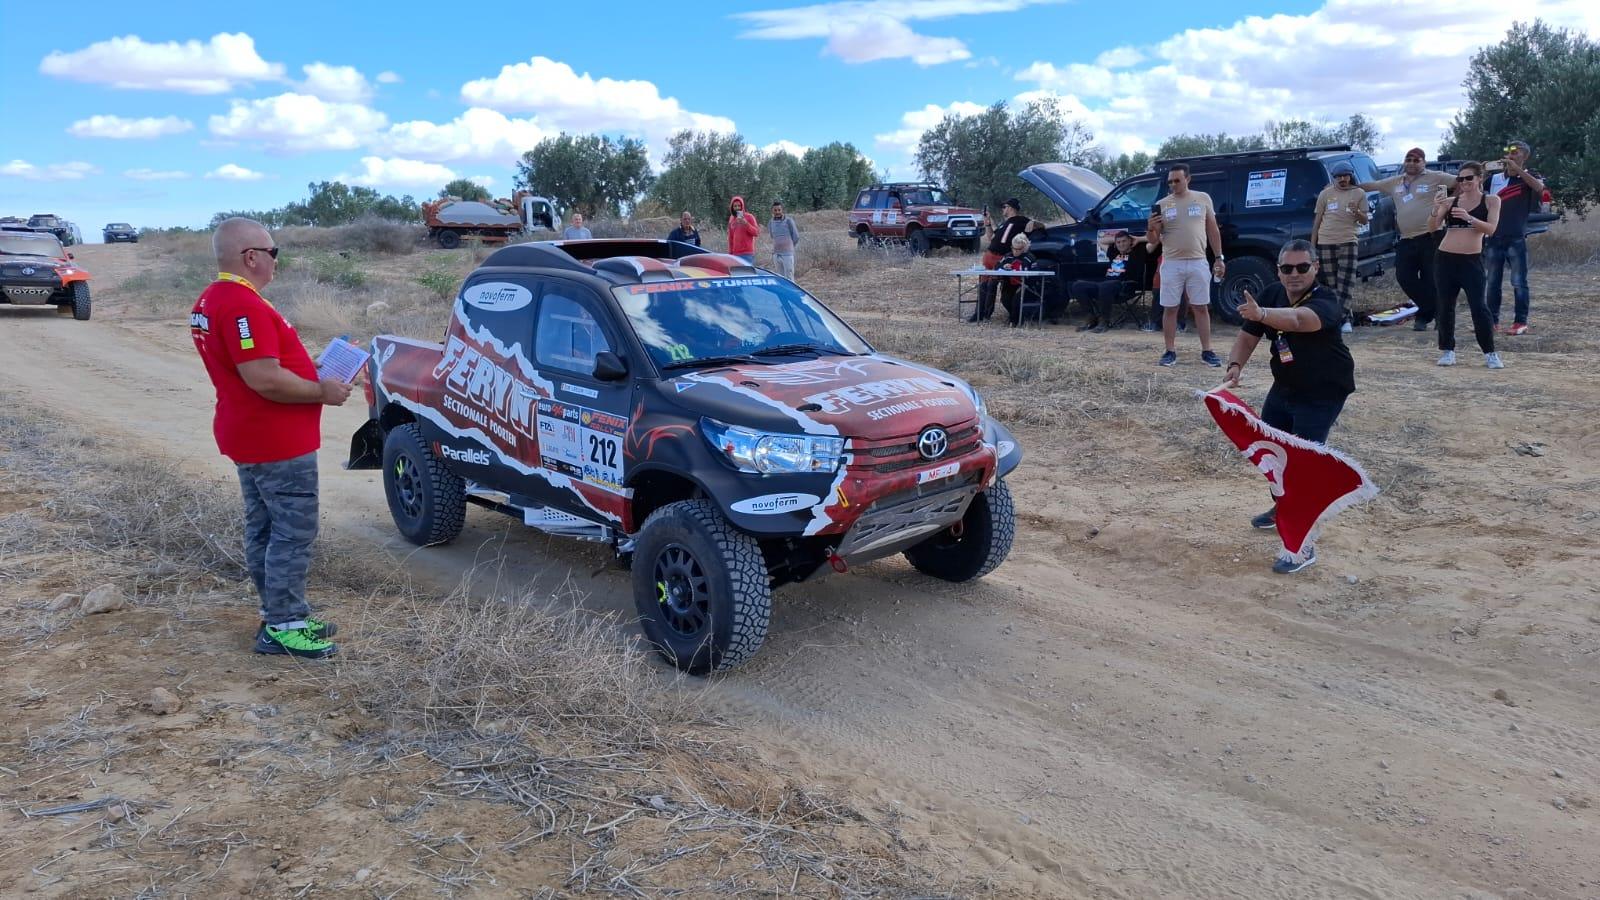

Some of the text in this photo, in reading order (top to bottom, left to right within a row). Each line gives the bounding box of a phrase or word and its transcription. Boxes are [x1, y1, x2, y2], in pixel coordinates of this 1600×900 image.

[480, 288, 516, 305] novoferm
[630, 278, 777, 295] FENIX TUNISIA
[237, 317, 251, 339] ORGA
[432, 334, 538, 440] FERYN
[802, 377, 960, 415] FERYN
[443, 394, 517, 448] SECTIONALE POORTEN
[591, 411, 626, 429] FENIX
[867, 400, 922, 421] SECTIONALE
[441, 444, 490, 466] Parallels
[589, 434, 618, 469] 212
[752, 497, 799, 510] novoferm
